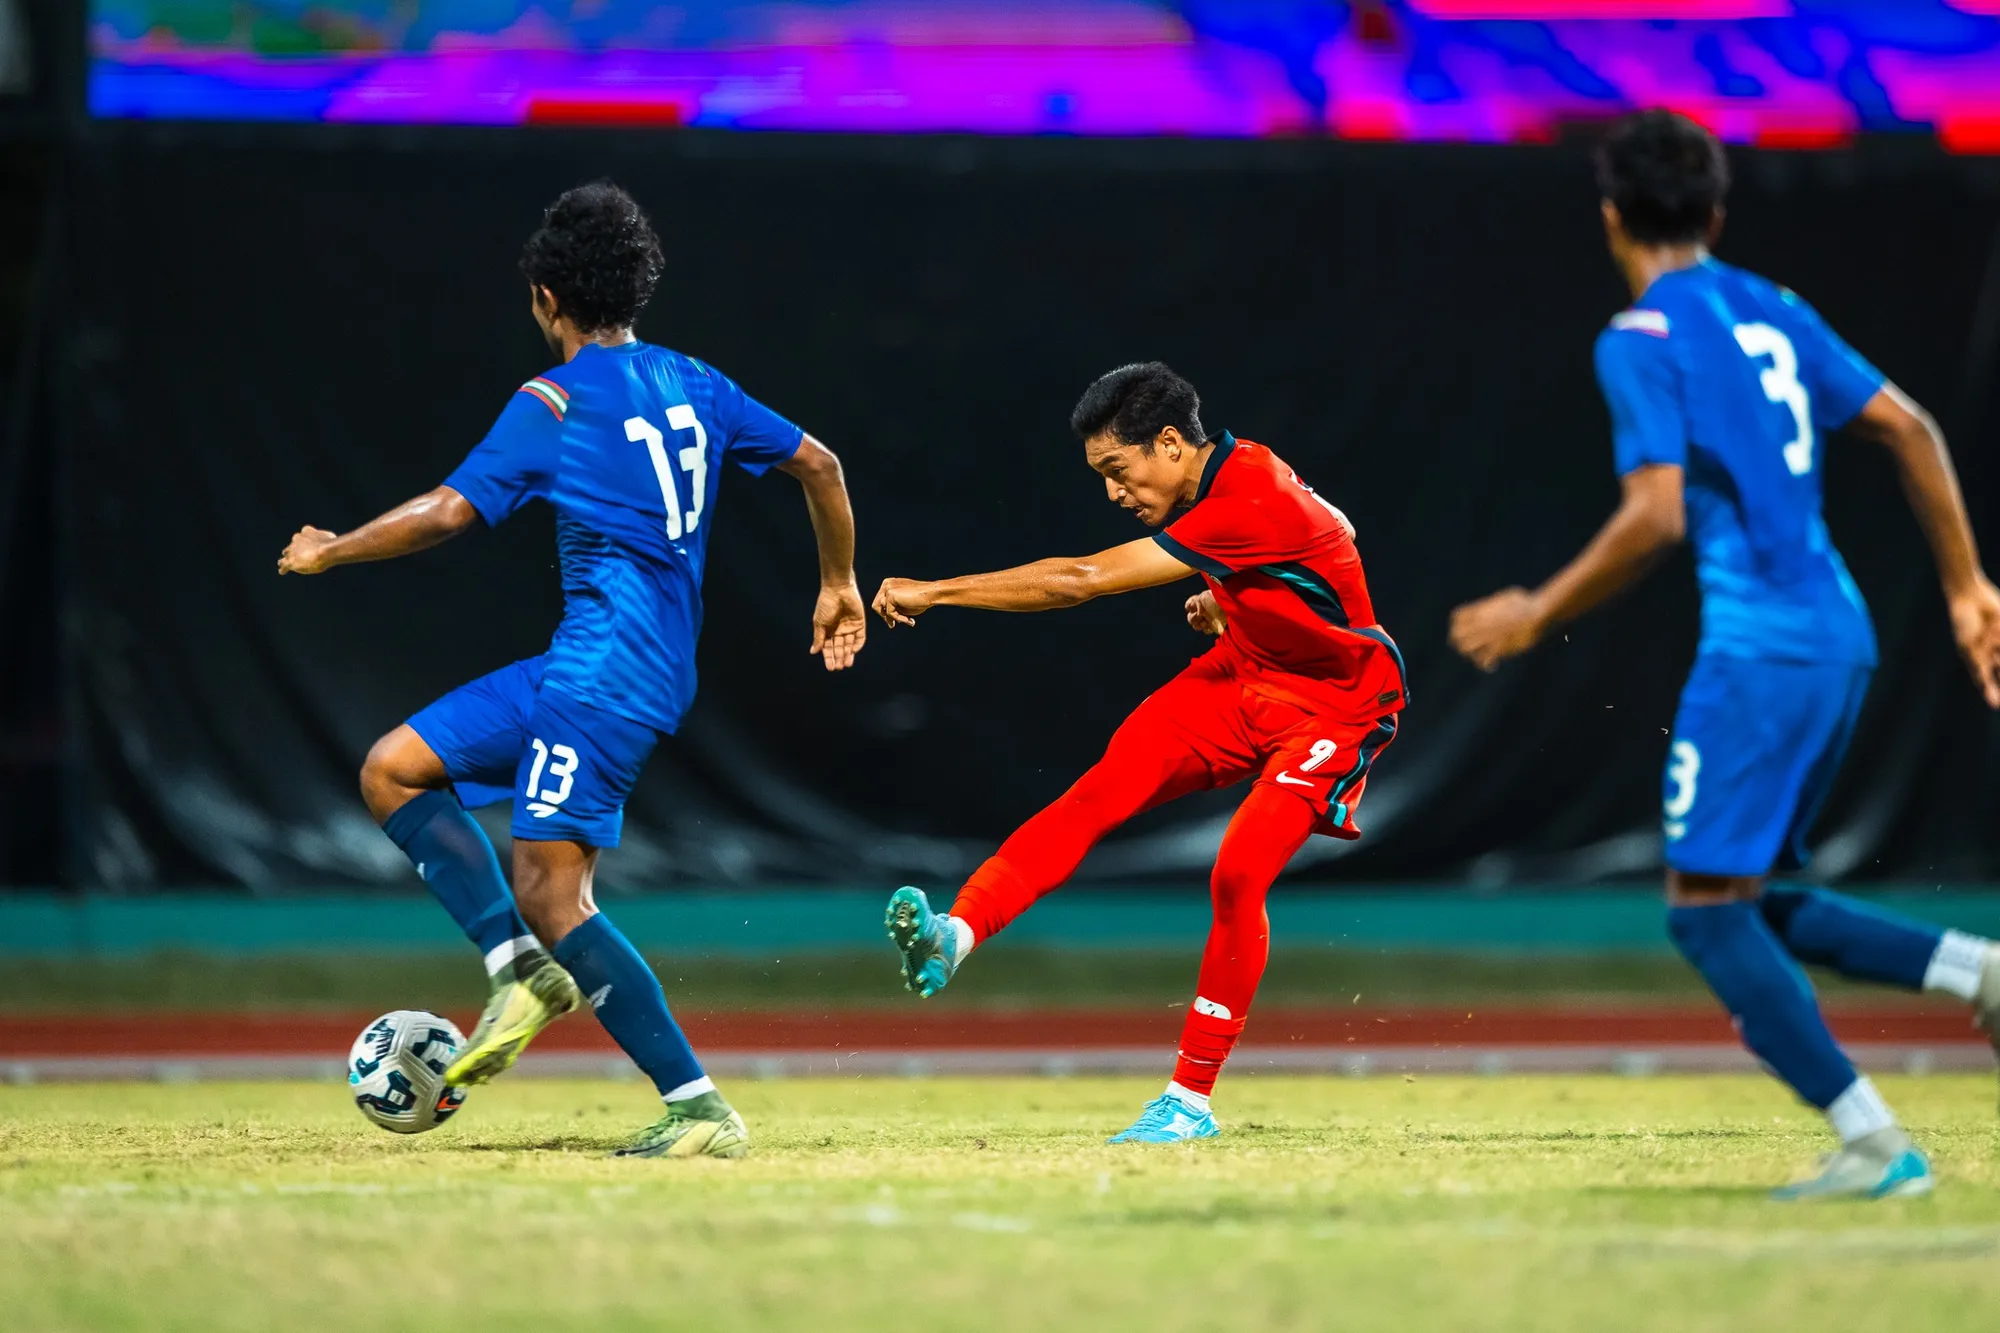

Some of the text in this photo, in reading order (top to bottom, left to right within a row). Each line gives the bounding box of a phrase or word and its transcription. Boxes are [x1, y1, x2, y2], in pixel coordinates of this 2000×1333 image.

[1733, 321, 1814, 476] 3
[624, 404, 708, 541] 13
[525, 738, 580, 805] 13
[1299, 738, 1338, 772] 9
[1664, 740, 1701, 818] 3
